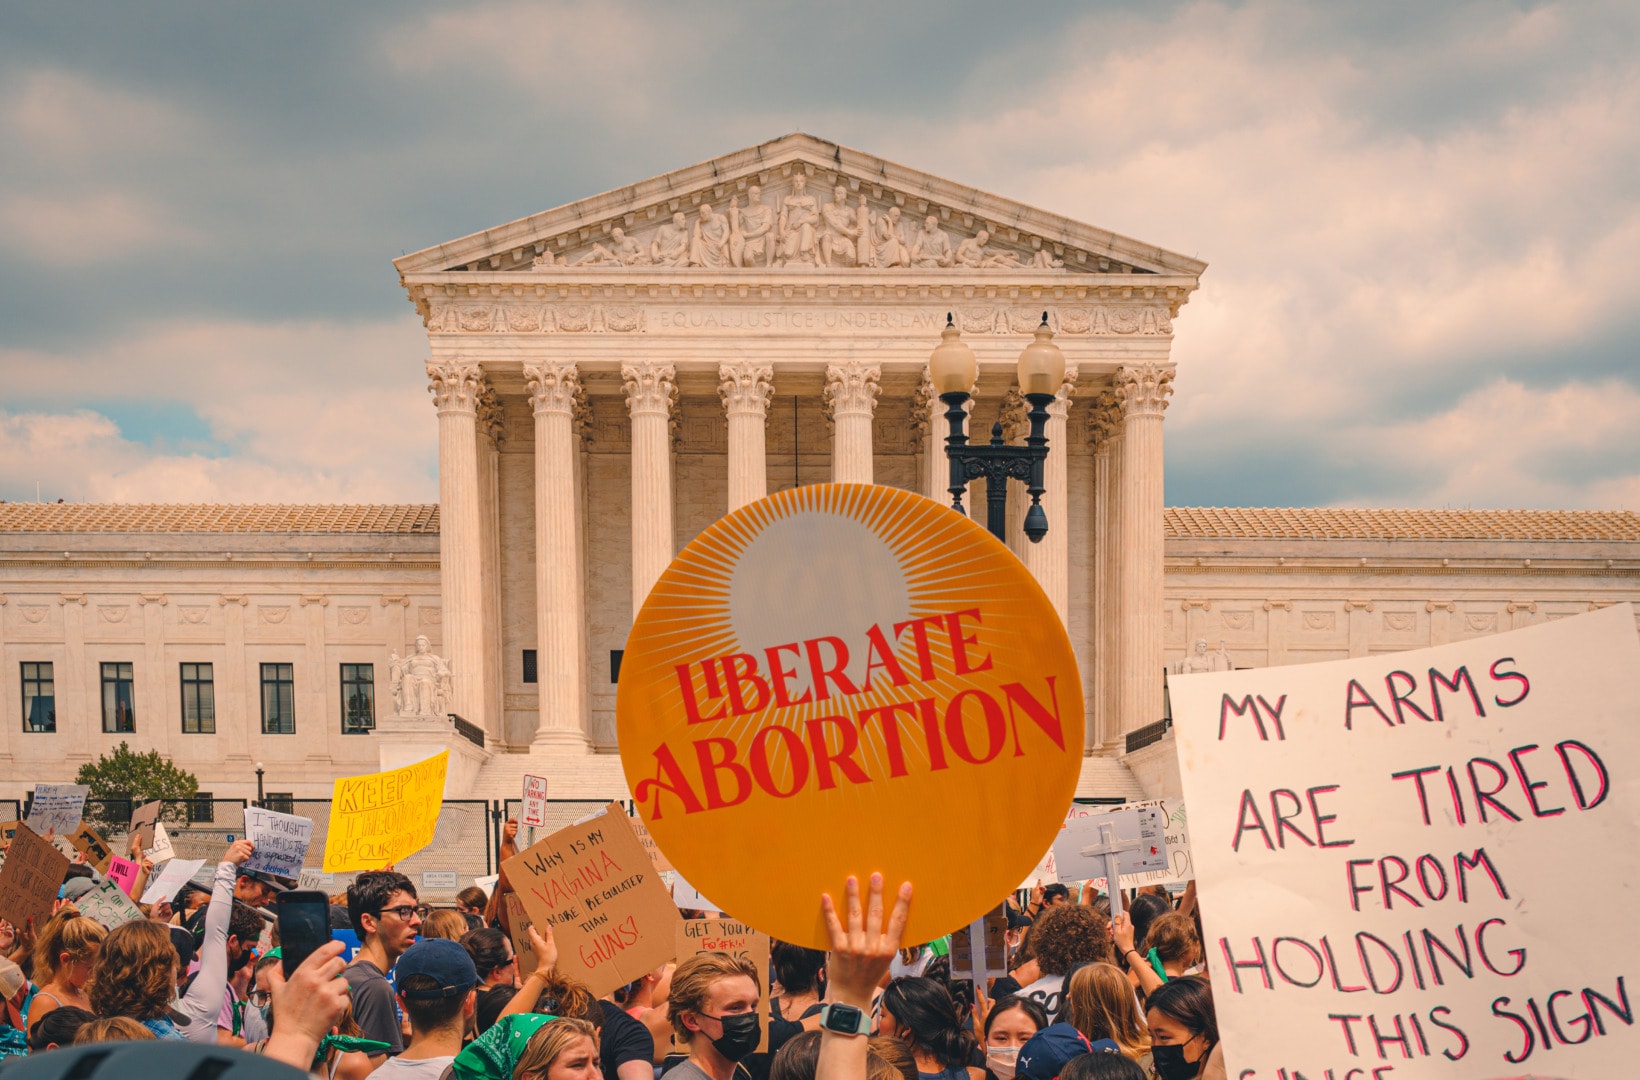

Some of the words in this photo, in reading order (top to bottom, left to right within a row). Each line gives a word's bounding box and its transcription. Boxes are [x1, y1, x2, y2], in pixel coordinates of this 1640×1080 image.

[661, 311, 729, 329] EQUAL
[733, 311, 814, 330] JUSTICE
[826, 311, 892, 329] UNDER
[901, 311, 938, 328] LAW
[674, 607, 993, 726] LIBERATE
[1218, 693, 1287, 741] MY
[1344, 657, 1530, 730] ARMS
[634, 676, 1067, 821] ABORTION
[338, 769, 413, 812] KEEP
[529, 780, 540, 789] NO
[1231, 785, 1355, 853] ARE
[1391, 740, 1610, 827] TIRED
[252, 812, 265, 827] I
[267, 816, 308, 837] THOUGHT
[115, 862, 129, 878] WILL
[329, 851, 355, 868] OF
[358, 841, 392, 860] OUR
[523, 852, 565, 877] WHY
[569, 839, 586, 855] IS
[587, 829, 605, 847] MY
[100, 880, 117, 894] I
[110, 894, 124, 908] am
[531, 850, 623, 909] VAGINA
[1346, 847, 1511, 912] FROM
[546, 906, 581, 928] MORE
[578, 912, 609, 934] THAN
[684, 922, 711, 938] GET
[579, 915, 644, 969] GUNS?
[1219, 918, 1527, 994] HOLDING
[1328, 1006, 1470, 1061] THIS
[1491, 976, 1635, 1064] SIGN
